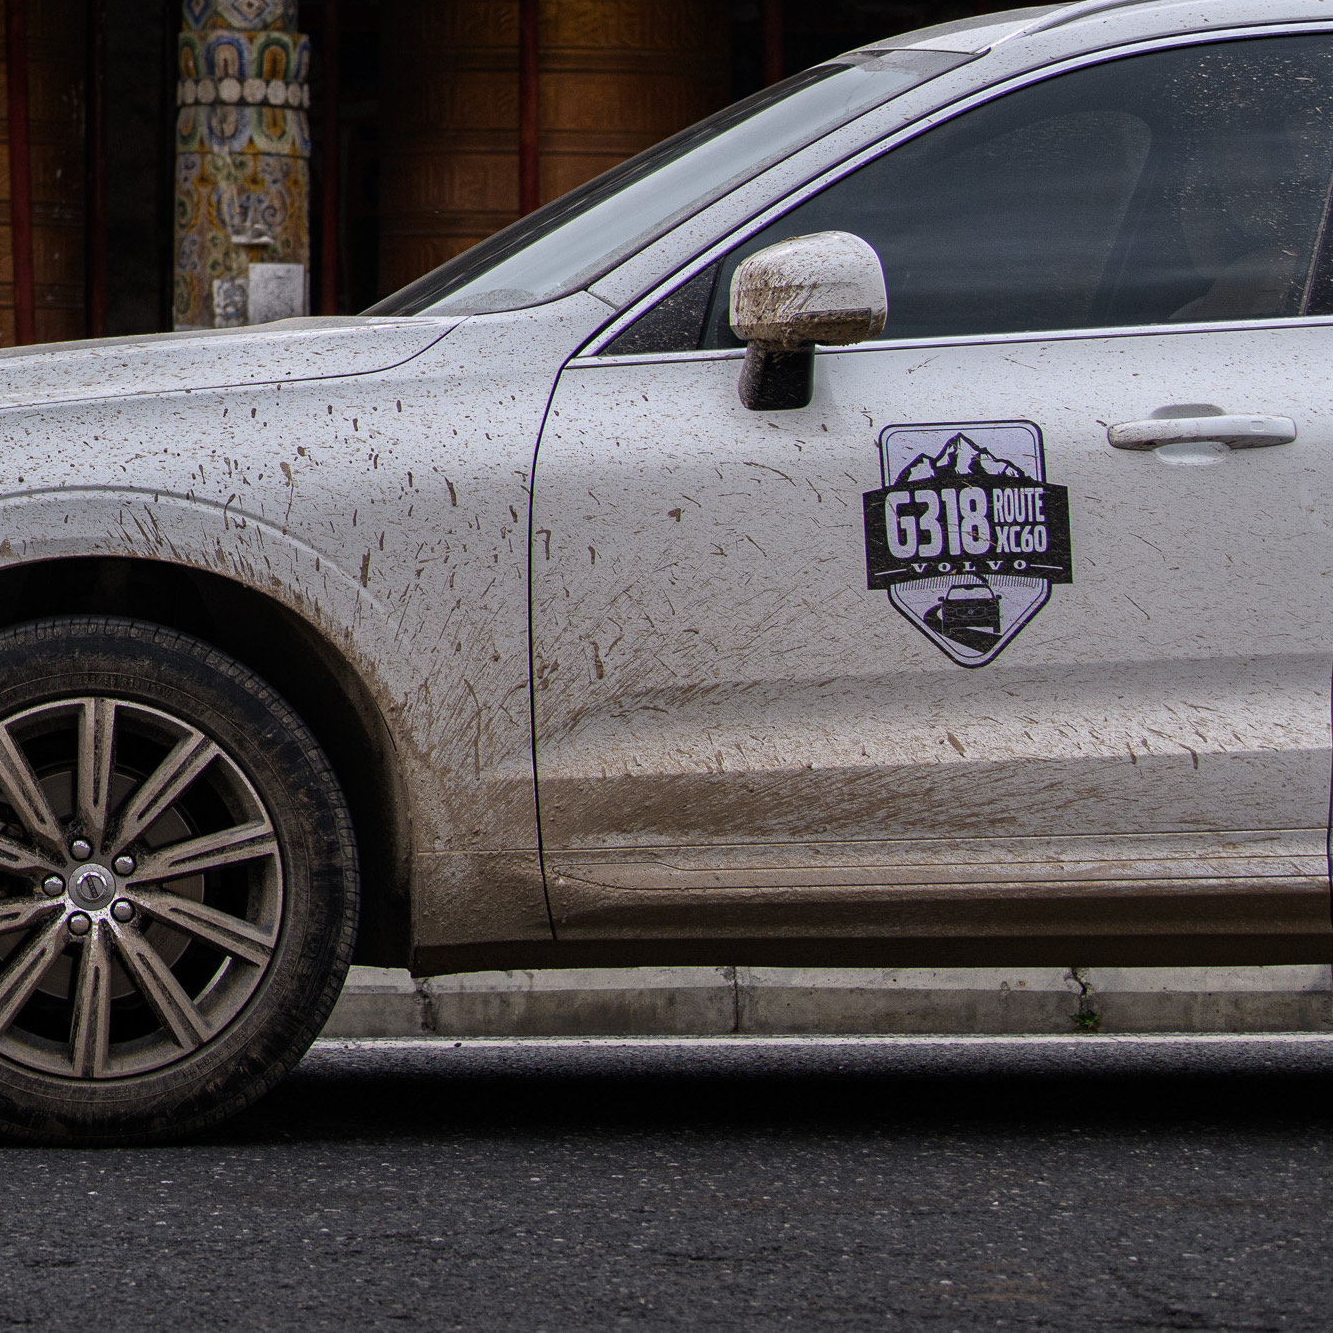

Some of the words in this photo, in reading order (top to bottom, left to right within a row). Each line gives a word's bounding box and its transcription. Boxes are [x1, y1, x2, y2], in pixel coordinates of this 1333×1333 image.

[993, 487, 1046, 522] ROUTE
[885, 487, 992, 559] G318
[995, 525, 1047, 553] XC60
[911, 560, 1027, 573] VOLVO
